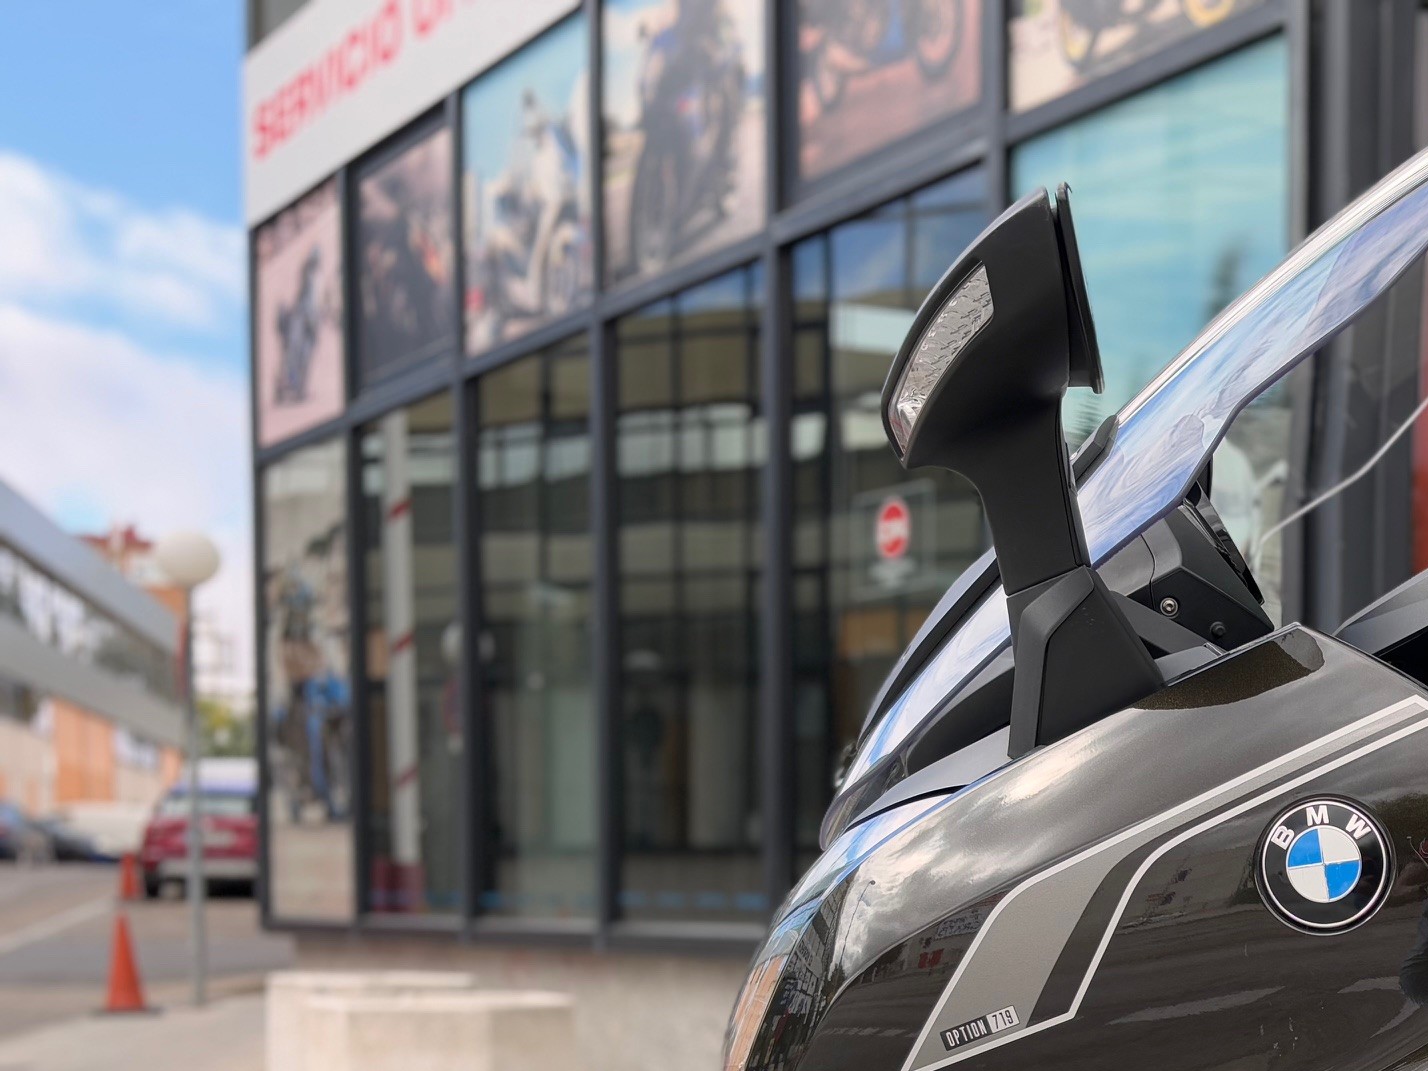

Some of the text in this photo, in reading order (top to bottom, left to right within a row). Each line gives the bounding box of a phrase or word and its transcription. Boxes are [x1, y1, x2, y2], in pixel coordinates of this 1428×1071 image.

[253, 0, 403, 160] SERVICIO
[1270, 804, 1372, 851] BMW
[945, 1009, 1014, 1047] OPTION 719
